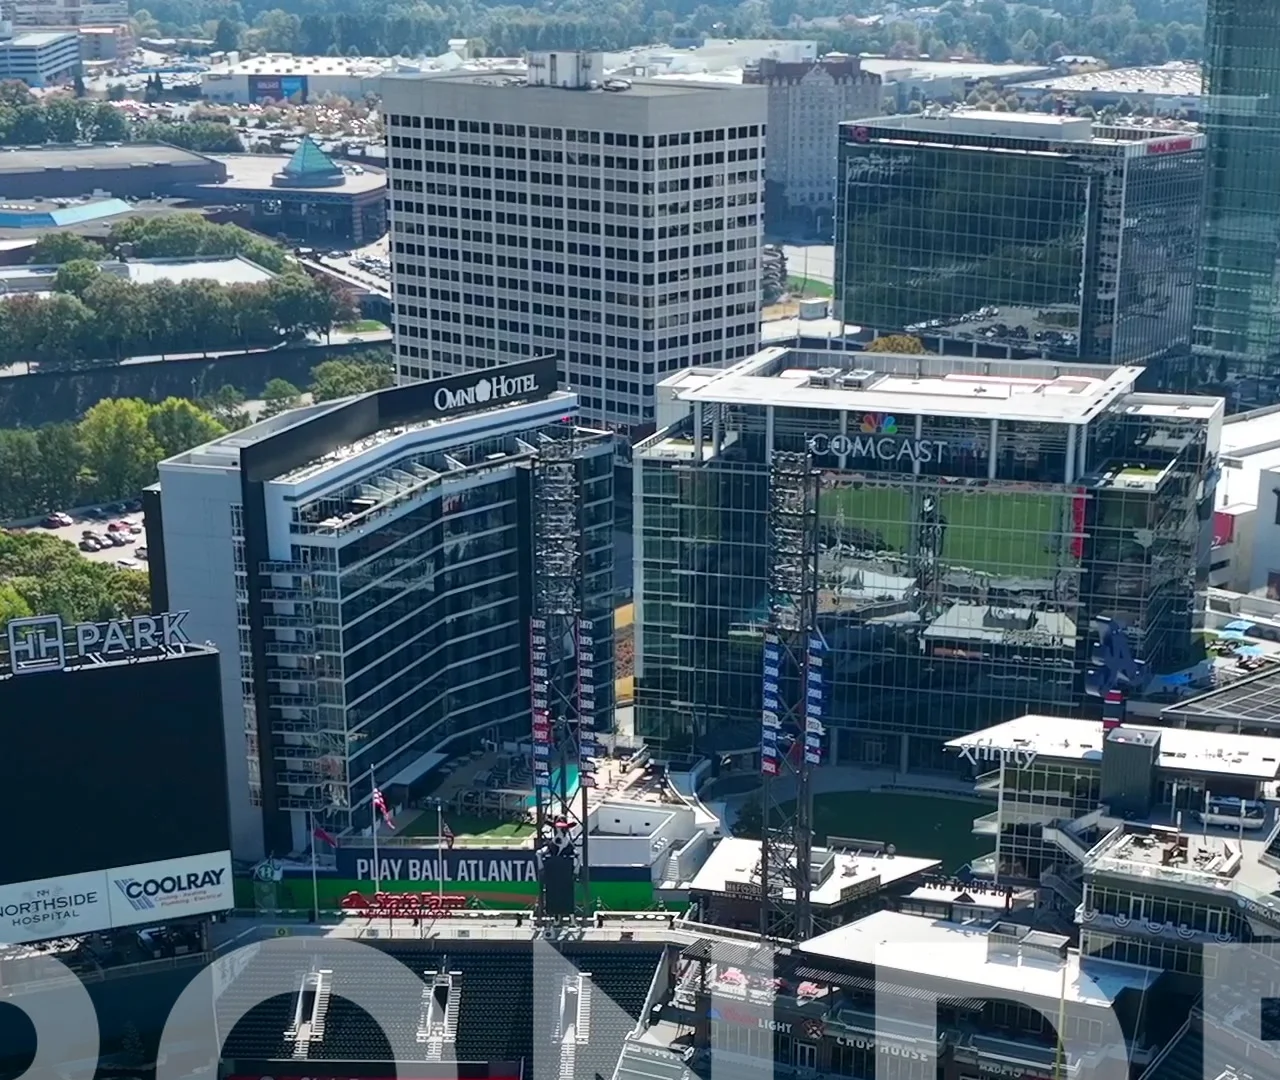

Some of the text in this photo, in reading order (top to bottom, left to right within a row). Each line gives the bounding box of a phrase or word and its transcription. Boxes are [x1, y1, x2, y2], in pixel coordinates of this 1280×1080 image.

[434, 374, 539, 411] OMNI HOTEL
[810, 433, 947, 464] COMCAST
[77, 610, 191, 657] PARK
[958, 739, 1037, 771] xfinity
[125, 868, 225, 900] COOLRAY
[357, 858, 538, 883] PLAY BALL ATLANTA
[12, 909, 80, 927] HOSPITAL
[758, 1018, 792, 1034] LIGHT
